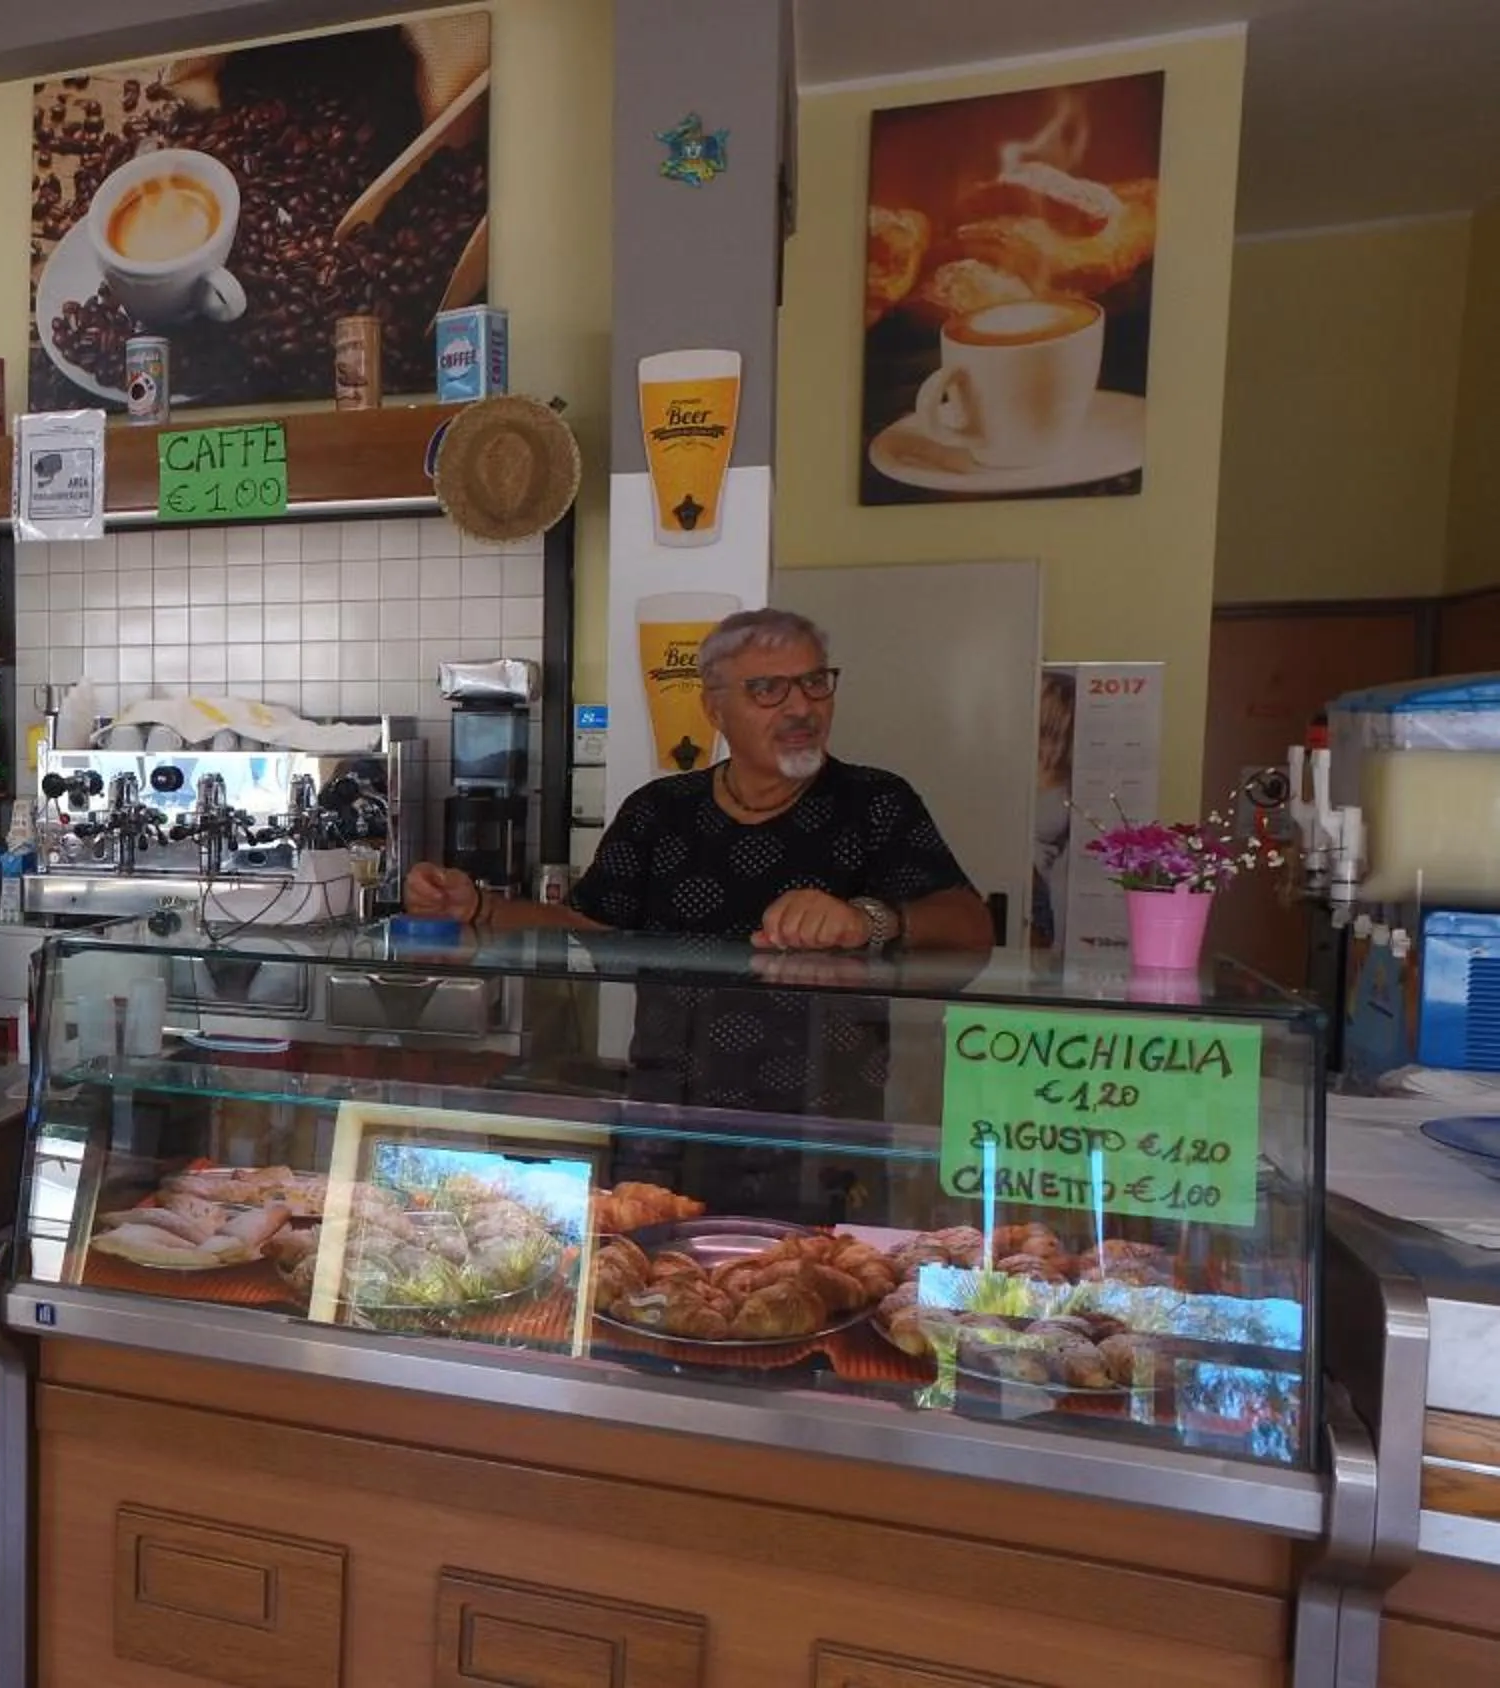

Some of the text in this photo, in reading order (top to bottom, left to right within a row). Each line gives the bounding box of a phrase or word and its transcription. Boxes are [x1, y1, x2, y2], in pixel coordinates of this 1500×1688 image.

[666, 404, 713, 426] Beer
[1089, 678, 1147, 696] 2017
[956, 1024, 1232, 1078] CONCHIGLIA
[969, 1120, 1126, 1155] BIGUSTO
